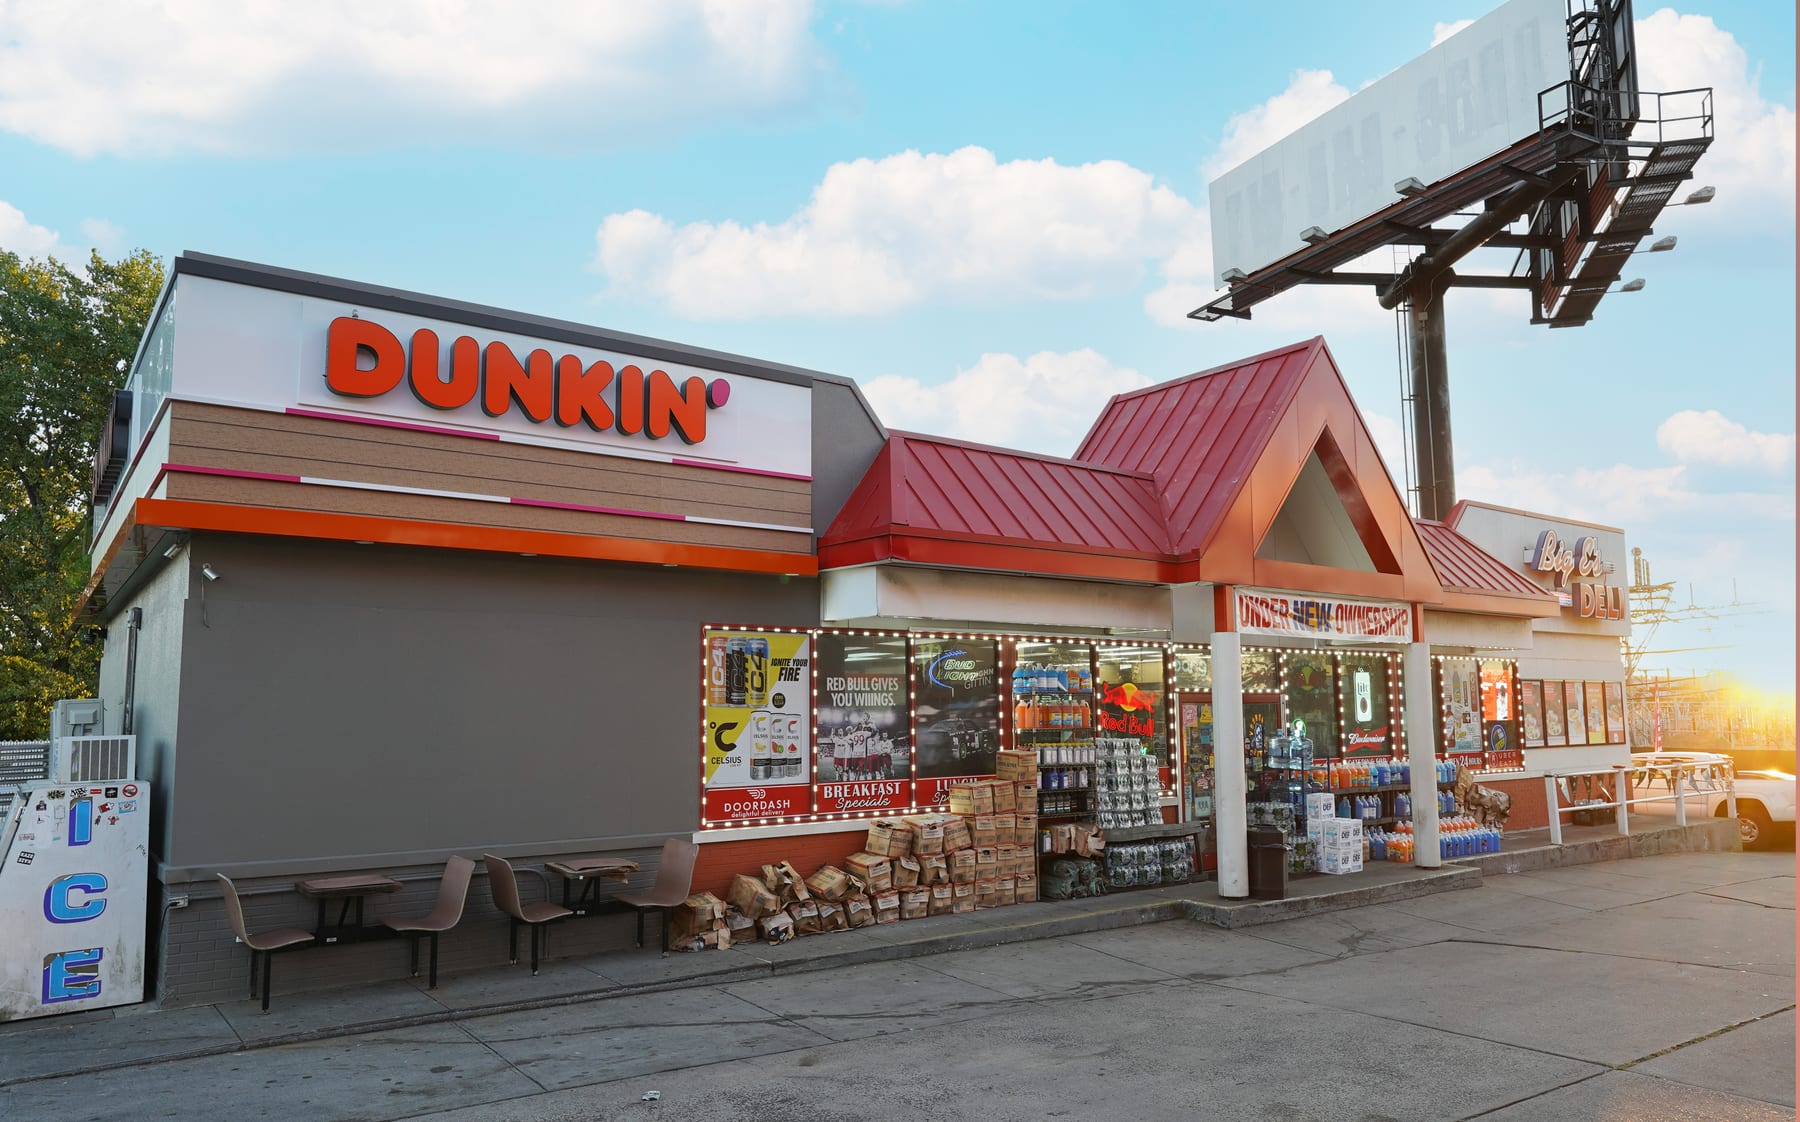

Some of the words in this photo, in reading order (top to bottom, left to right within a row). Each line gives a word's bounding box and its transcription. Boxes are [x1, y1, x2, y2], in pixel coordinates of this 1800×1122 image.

[325, 316, 730, 445] DUNKIN'
[1535, 530, 1575, 588] Big
[1579, 582, 1625, 620] DELI
[1238, 594, 1290, 631] UNDER
[1293, 600, 1332, 633] NEW
[1335, 603, 1409, 637] OWNERSHIP
[771, 658, 791, 667] IGNITE
[792, 659, 808, 667] YOUR
[944, 659, 976, 670] BUD
[778, 667, 801, 682] FIRE
[826, 677, 846, 691] RED
[847, 677, 870, 691] BULL
[871, 677, 899, 691] GIVES
[831, 692, 852, 706] YOU
[1100, 710, 1127, 732] Red
[1129, 715, 1155, 737] Bull
[1348, 733, 1386, 745] Budweiser
[711, 756, 742, 765] CELSIUS
[823, 782, 901, 799] BREAKFAST
[724, 799, 791, 812] DOORDASH
[835, 793, 891, 812] Specials
[731, 809, 760, 818] delightful
